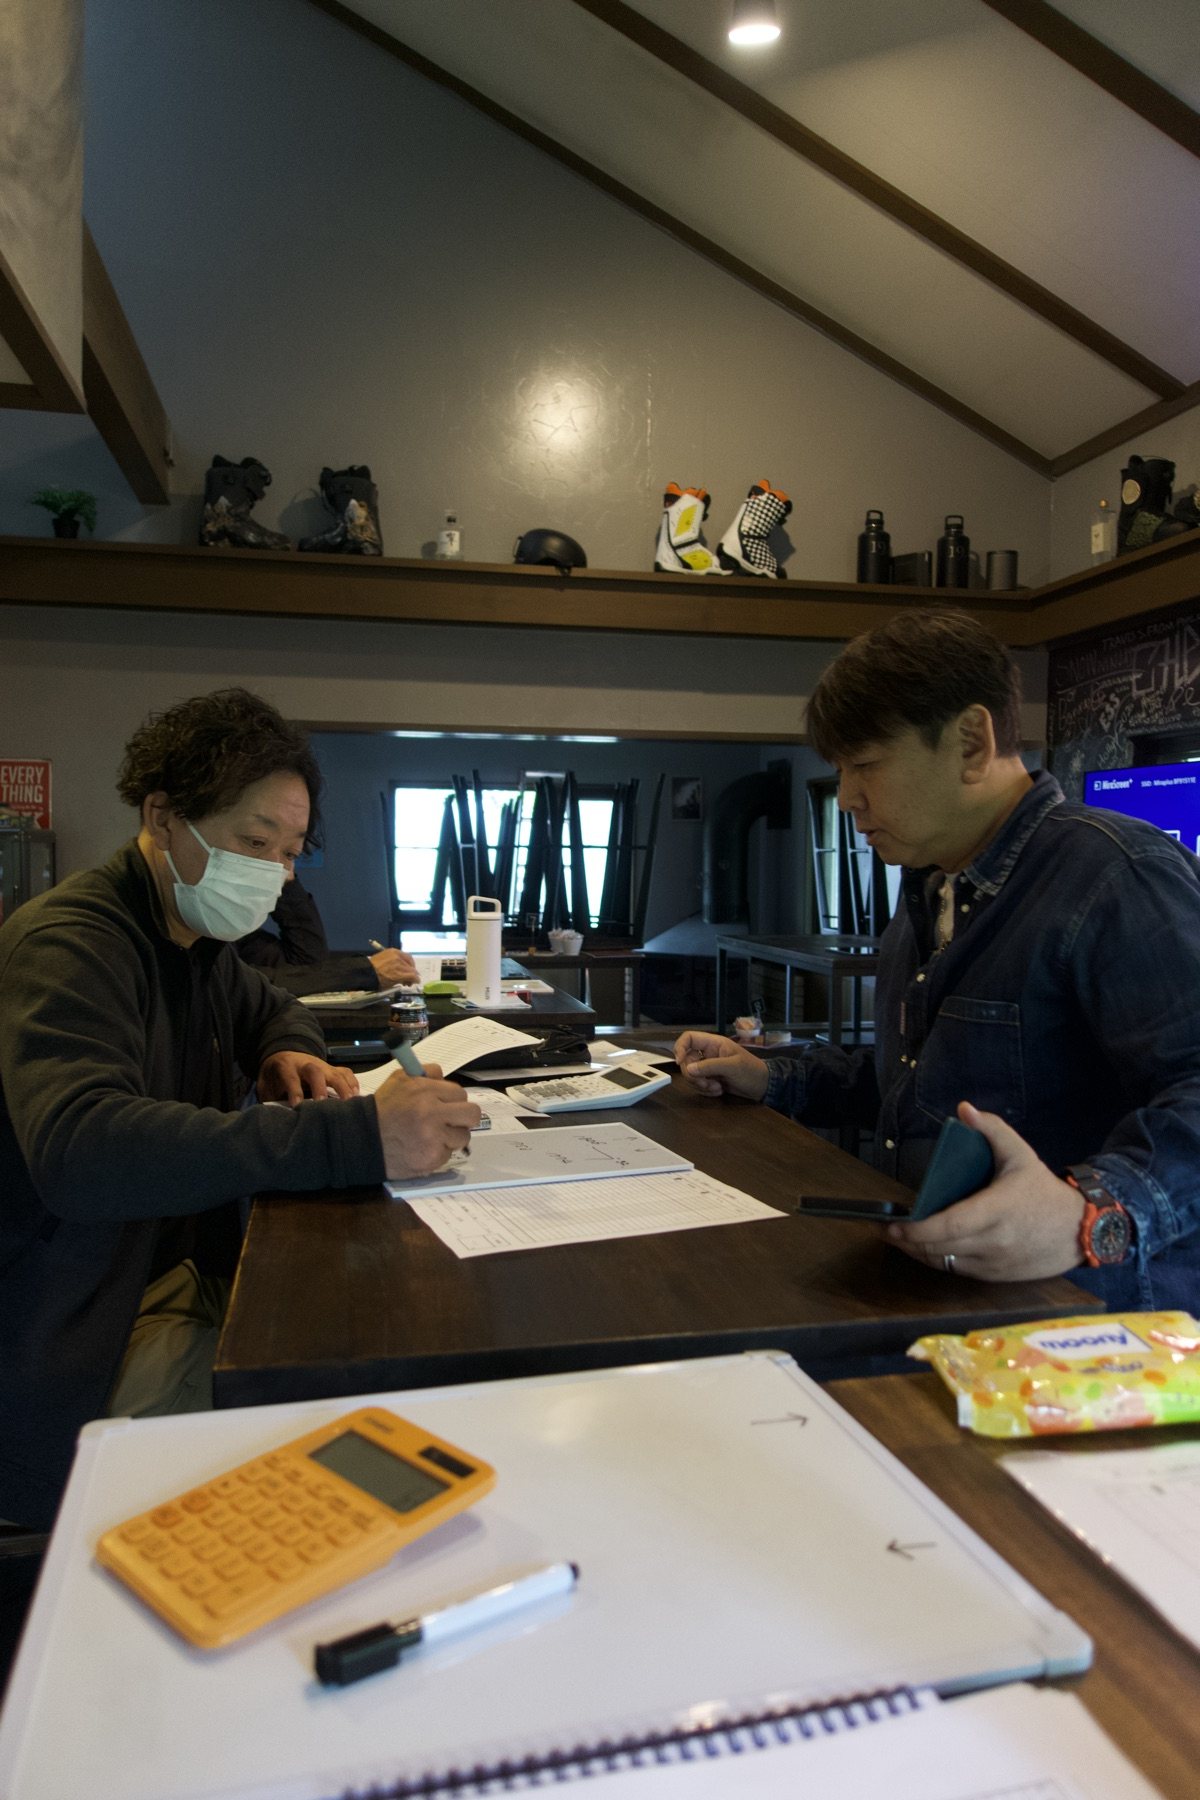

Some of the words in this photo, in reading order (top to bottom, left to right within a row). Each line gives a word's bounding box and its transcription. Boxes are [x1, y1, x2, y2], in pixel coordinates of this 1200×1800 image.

[0, 765, 44, 784] EVERY
[1, 783, 44, 803] THING
[1039, 1333, 1128, 1350] moony
